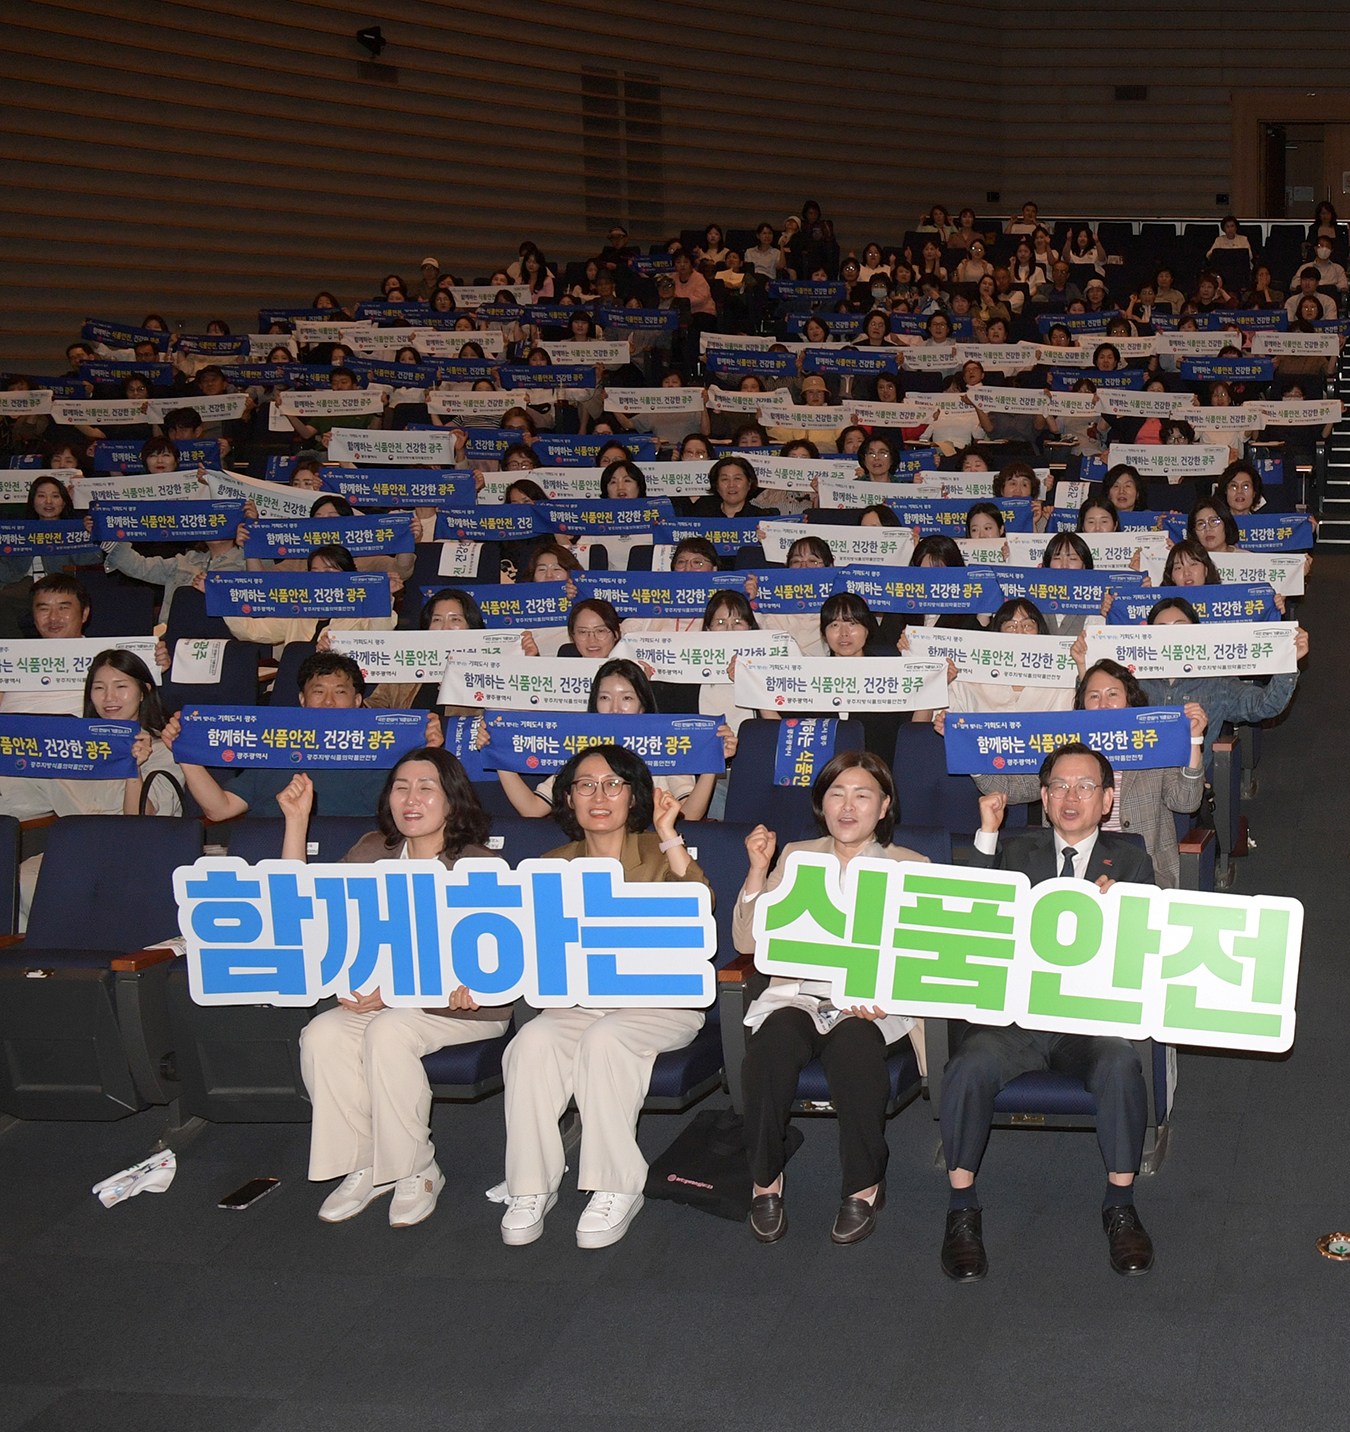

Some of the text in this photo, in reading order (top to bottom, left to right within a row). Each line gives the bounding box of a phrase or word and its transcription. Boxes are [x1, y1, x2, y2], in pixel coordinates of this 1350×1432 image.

[106, 514, 227, 528] 함께하는 식품안전, 건강한 광주
[267, 529, 394, 545] 함께하는 식품안전, 건강한 광주
[230, 588, 366, 603] 함께하는 식품안전, 건강한 광주
[846, 580, 982, 598] 함께하는 식품안전, 건강한 광주
[1212, 600, 1264, 616] 건강한 광주
[928, 646, 1053, 669] 함께하는 식품안전, 건강한
[1116, 643, 1273, 661] 함께하는 식품안전, 건강한 광주
[464, 673, 592, 693] 함께하는 식품안전, 건강한
[766, 677, 923, 694] 함께하는 식품안전, 건강한 광주
[44, 739, 112, 759] 건강한 광주
[208, 729, 395, 749] 함께하는 식품안전, 건강한 광주
[512, 735, 691, 755] 함께하는 건강한 광주
[977, 730, 1158, 753] 함께하는 건강한 광주
[185, 870, 705, 997] 함께하는
[764, 863, 1292, 1038] 식품안전
